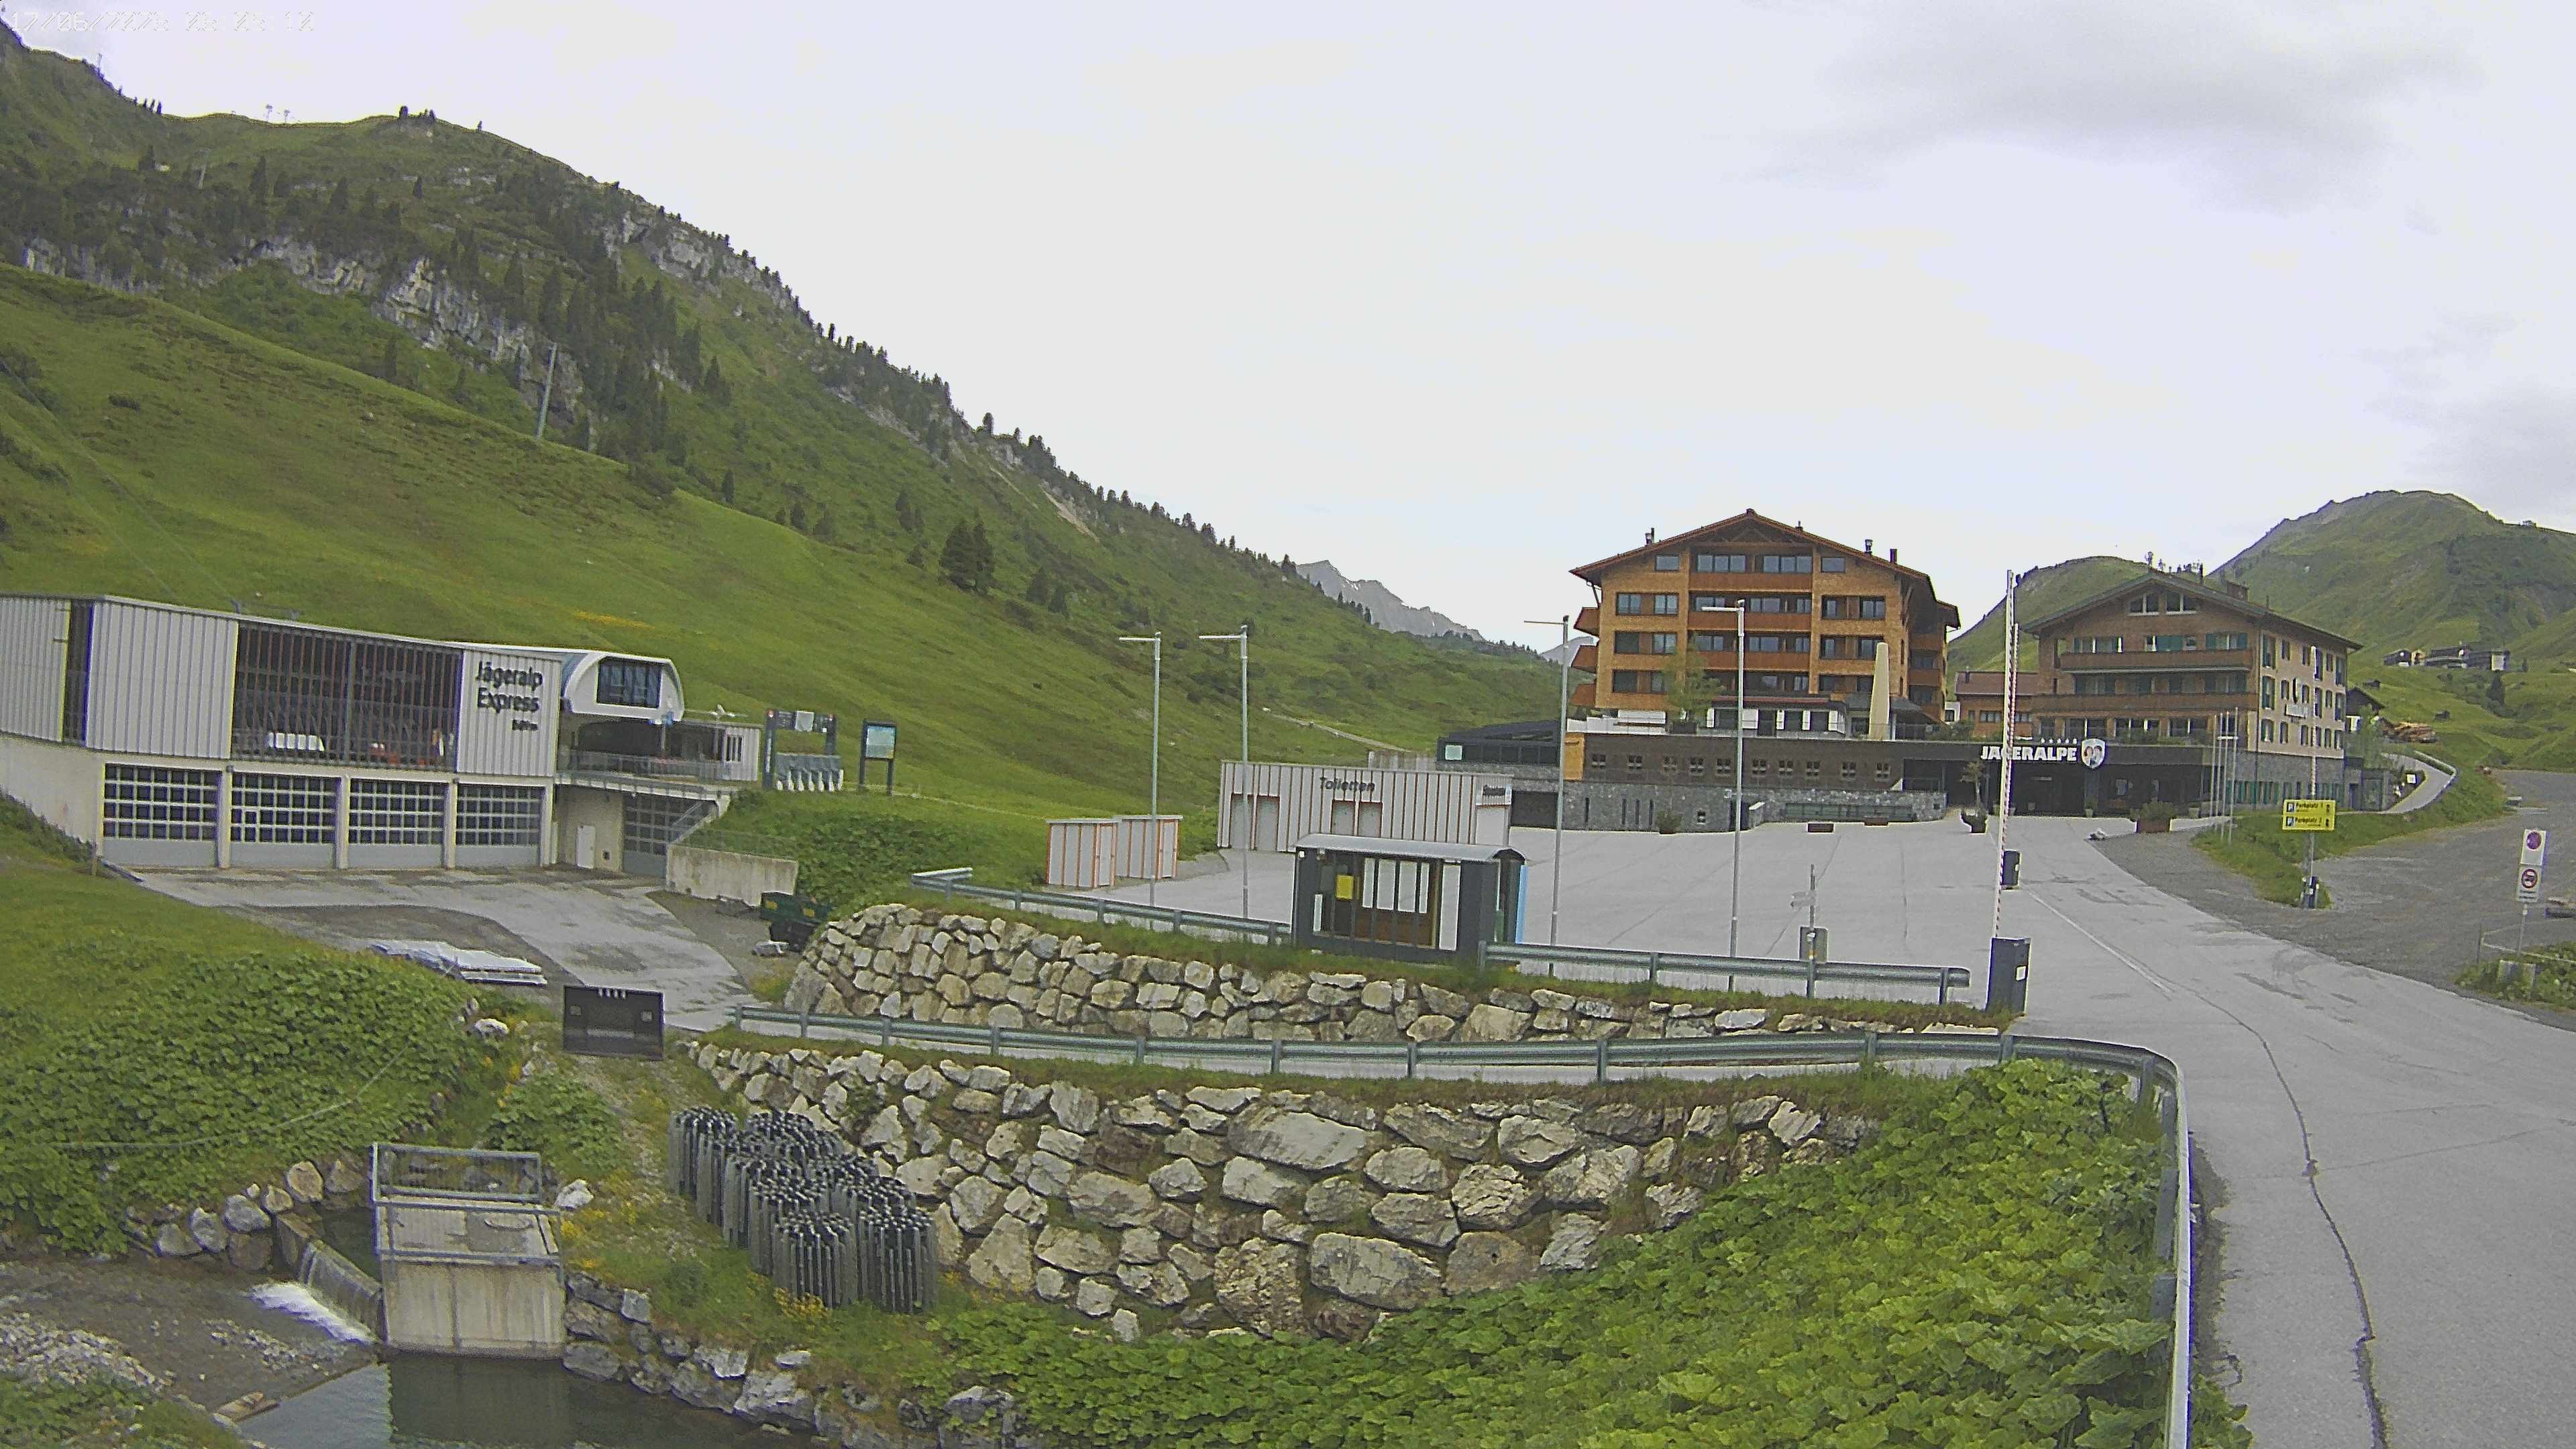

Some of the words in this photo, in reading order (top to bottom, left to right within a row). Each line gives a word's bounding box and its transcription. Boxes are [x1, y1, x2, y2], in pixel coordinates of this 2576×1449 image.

[475, 661, 543, 692] Jägeralp
[477, 687, 540, 713] Express
[1319, 776, 1376, 792] Toiletten
[2295, 816, 2318, 824] Parkplatz
